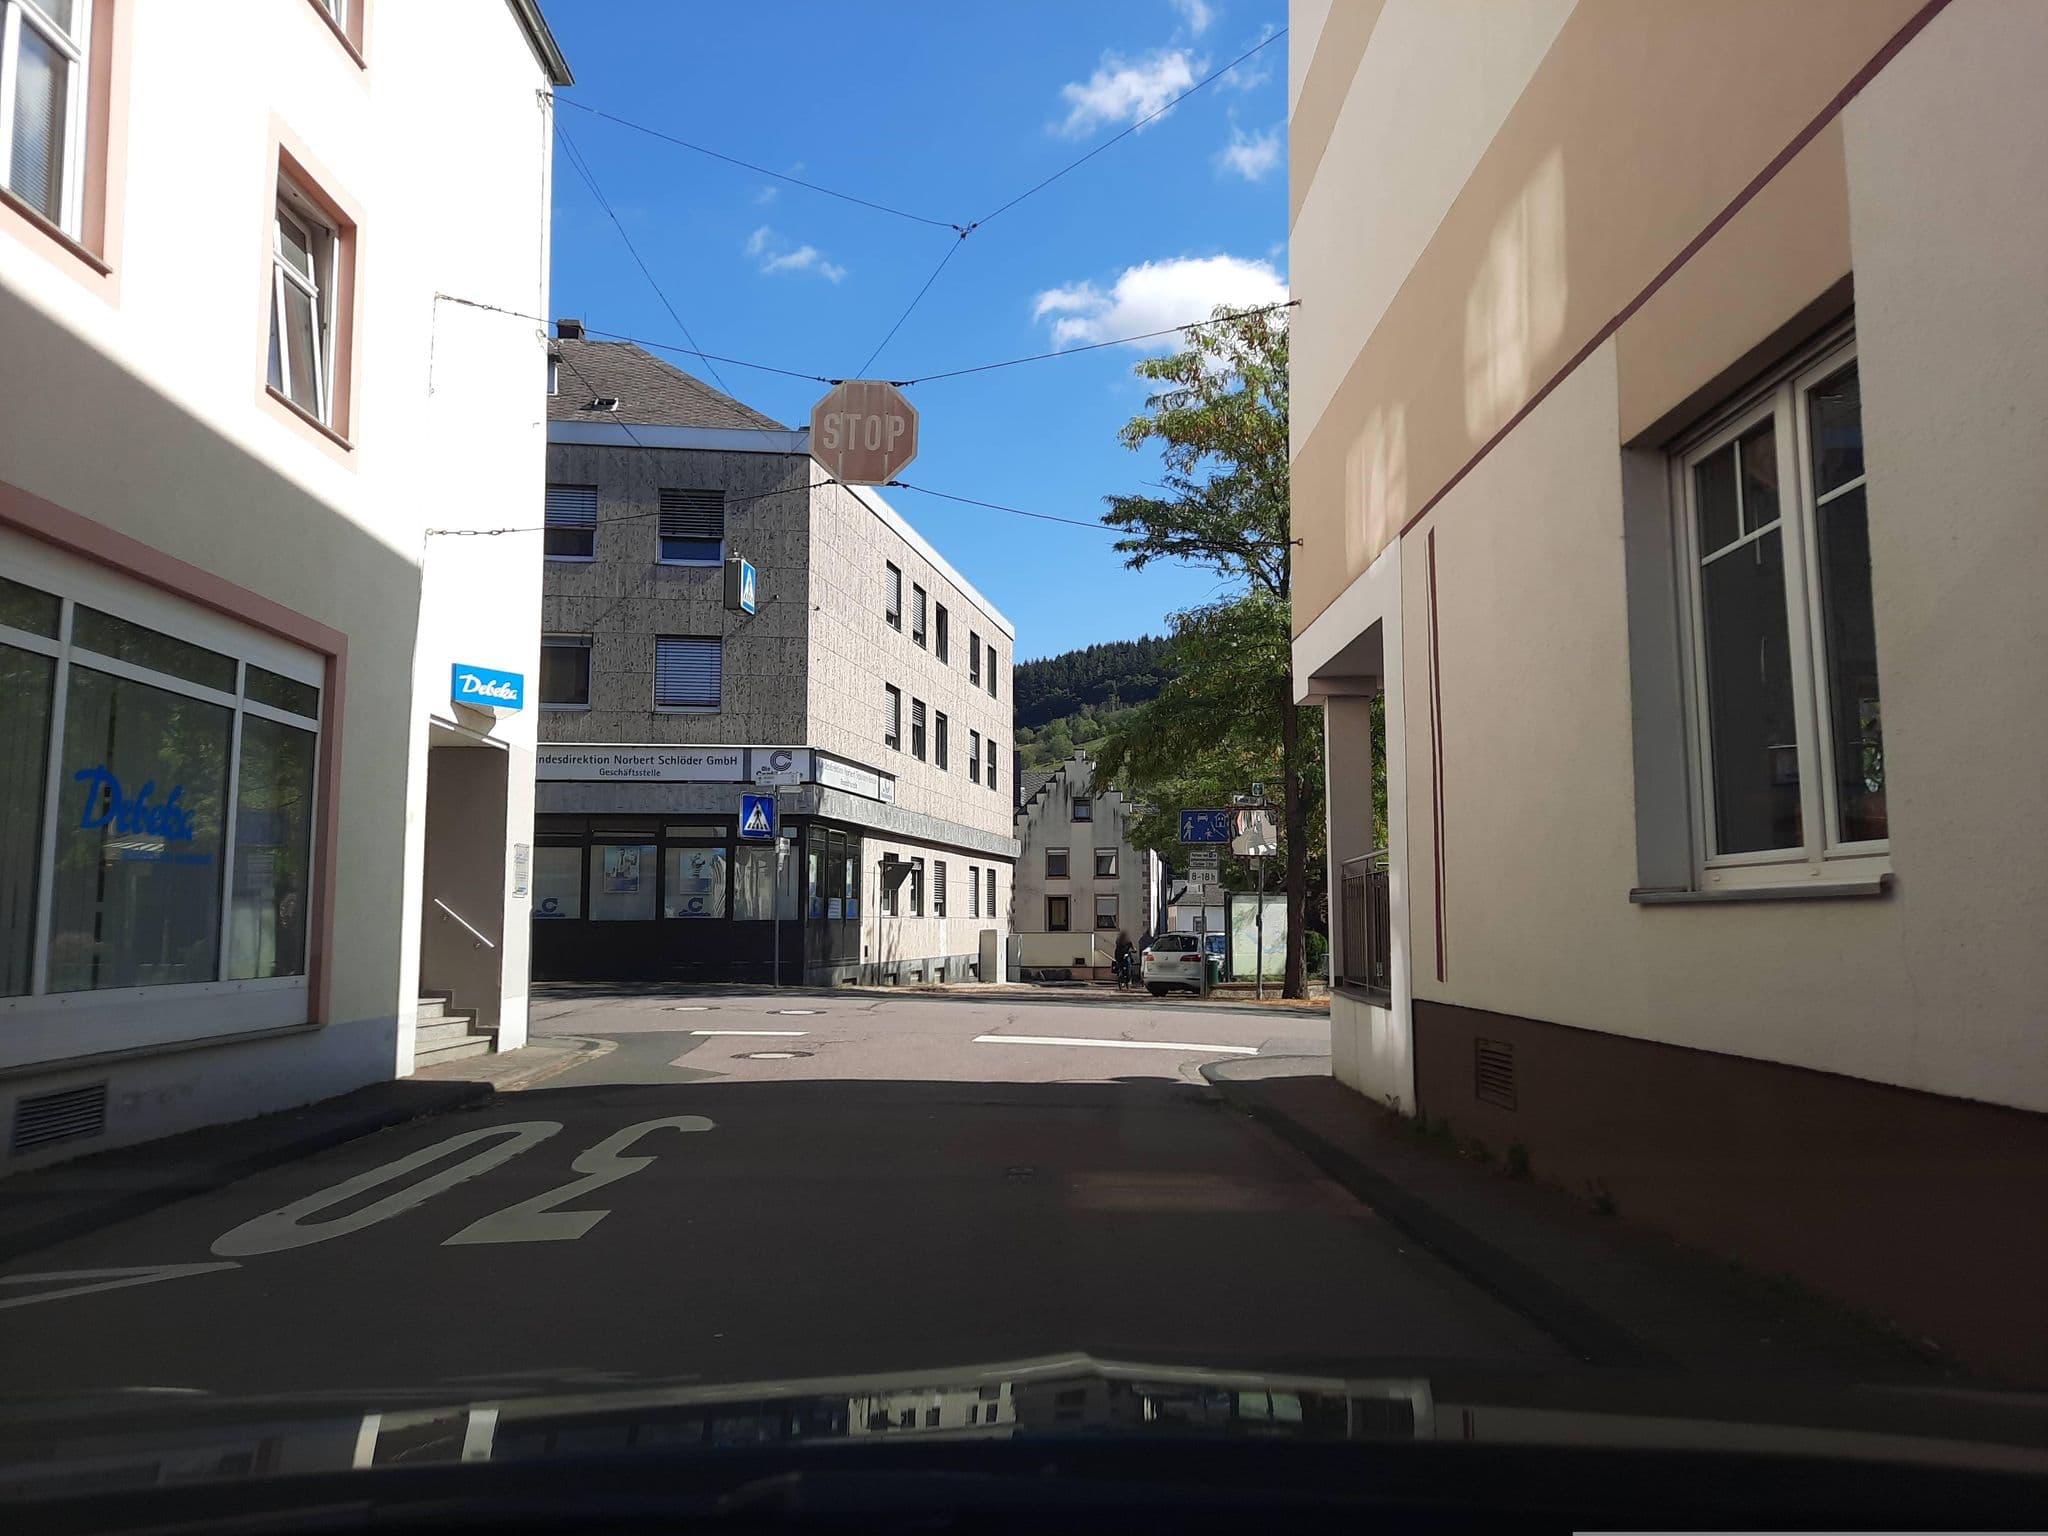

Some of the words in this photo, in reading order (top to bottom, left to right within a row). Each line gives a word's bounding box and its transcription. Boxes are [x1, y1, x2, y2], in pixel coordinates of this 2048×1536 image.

[823, 412, 905, 452] STOP
[459, 673, 518, 700] Debeka
[538, 754, 611, 765] ndesdirektion
[614, 755, 655, 765] Norbert
[658, 755, 703, 766] Schlöder
[706, 756, 738, 766] GmbH
[599, 767, 661, 777] Geschäftsstelle
